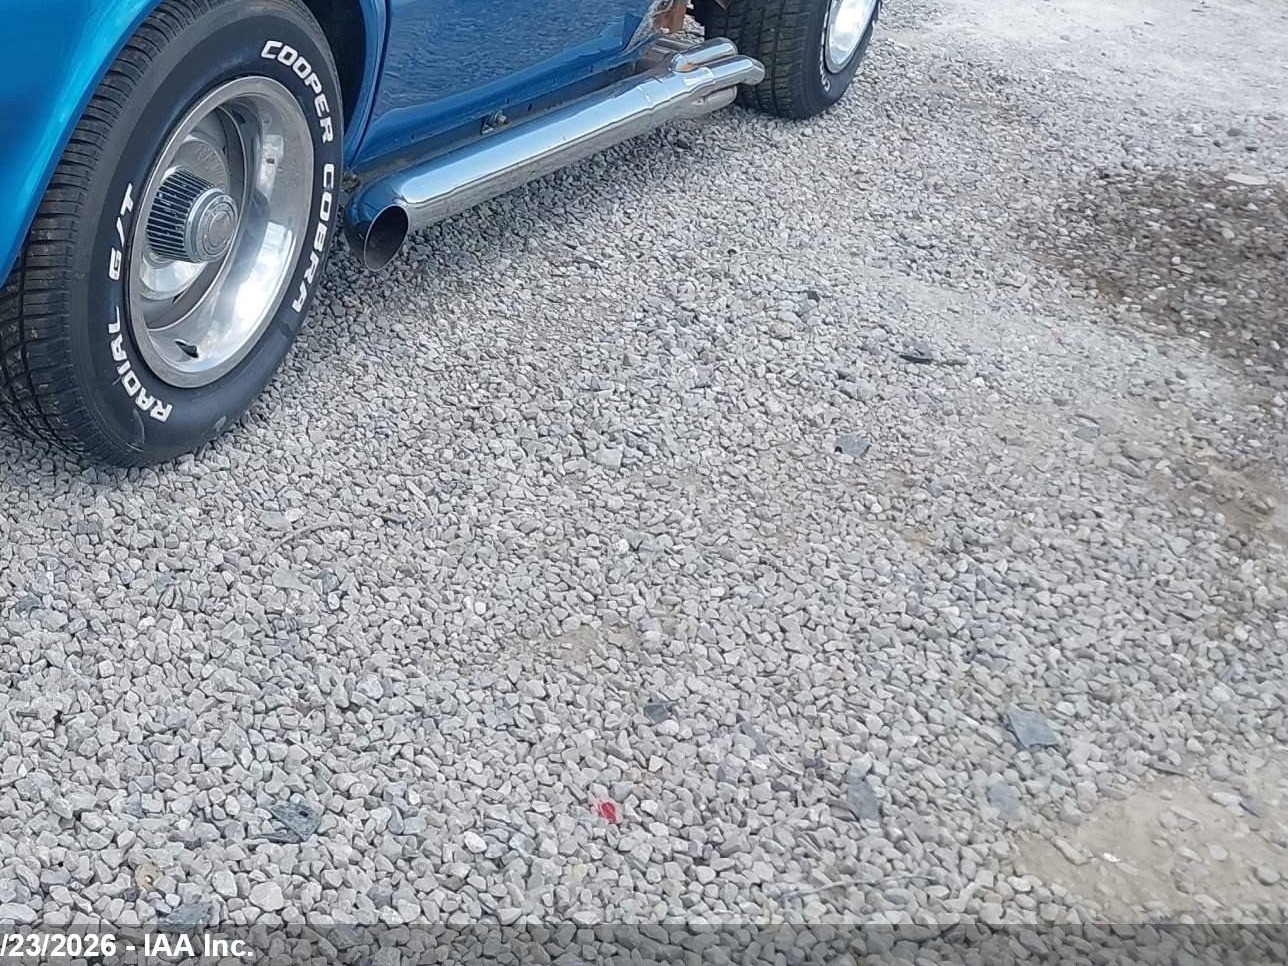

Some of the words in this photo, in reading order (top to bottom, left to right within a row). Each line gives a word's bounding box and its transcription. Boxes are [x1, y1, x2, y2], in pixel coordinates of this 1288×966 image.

[260, 40, 335, 144] COOPER
[108, 183, 135, 281] G/T
[292, 163, 335, 315] COBRA
[108, 306, 174, 423] RADIAL
